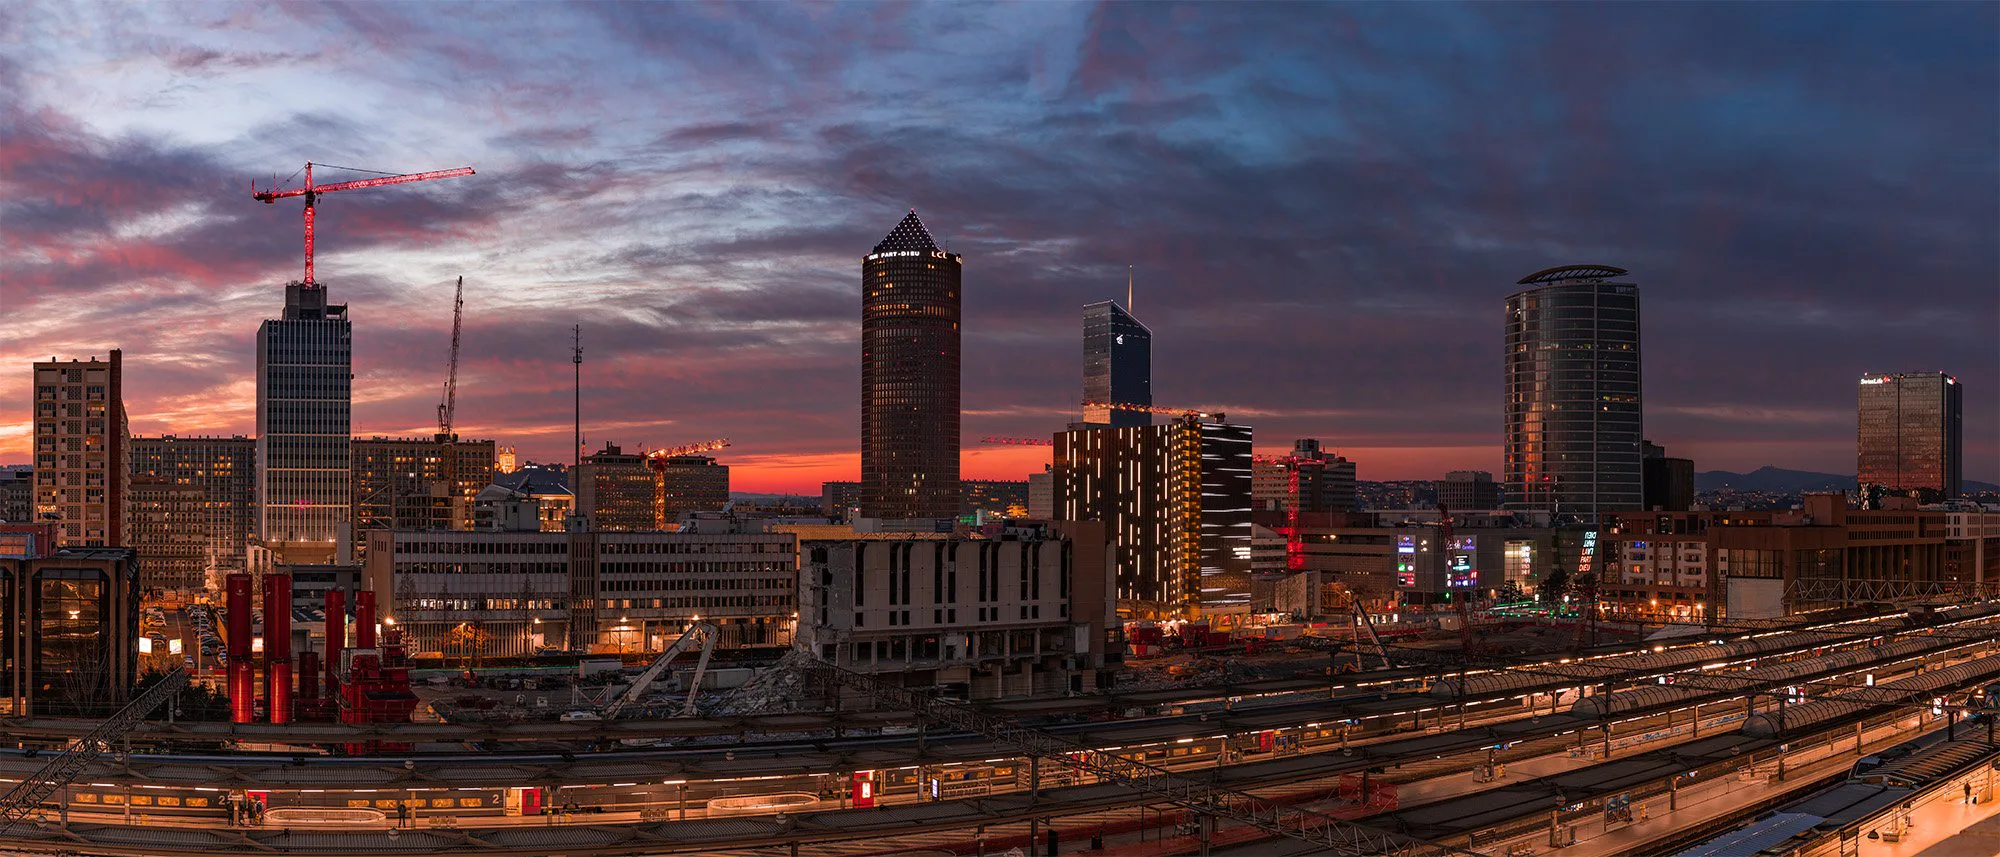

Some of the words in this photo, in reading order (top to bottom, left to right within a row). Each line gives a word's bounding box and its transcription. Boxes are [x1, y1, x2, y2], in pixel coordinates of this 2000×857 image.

[931, 251, 948, 259] LCL
[218, 795, 225, 805] 2
[492, 794, 499, 804] 2
